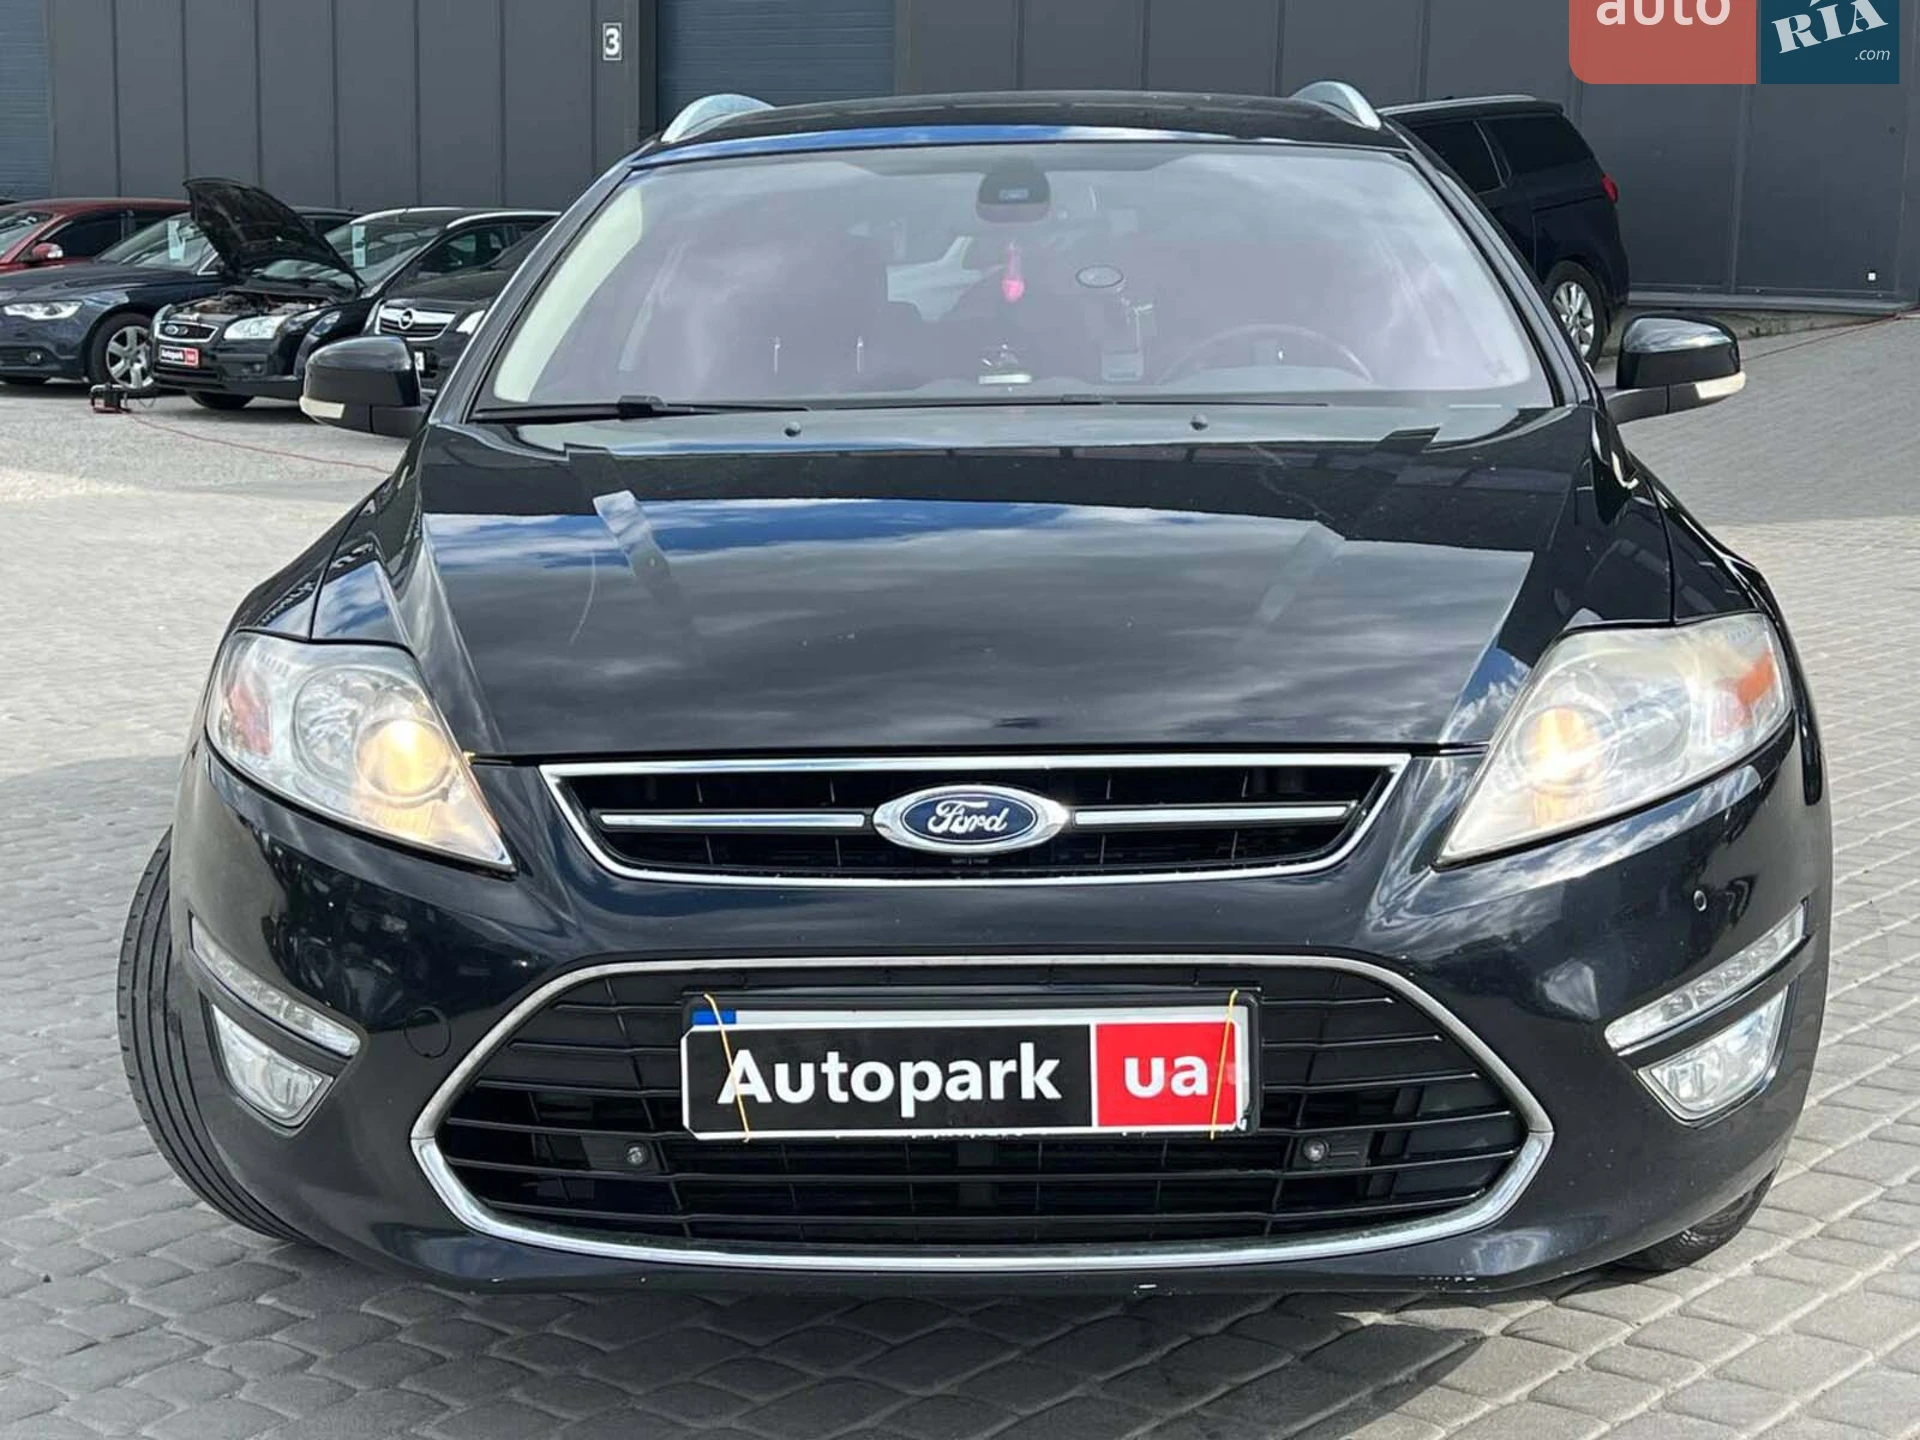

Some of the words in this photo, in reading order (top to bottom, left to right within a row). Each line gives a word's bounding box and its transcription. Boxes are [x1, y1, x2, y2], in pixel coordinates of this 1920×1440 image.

[605, 27, 620, 56] 3
[927, 800, 1010, 835] Ford
[717, 1042, 1063, 1118] Autopark
[1123, 1054, 1209, 1098] ua
